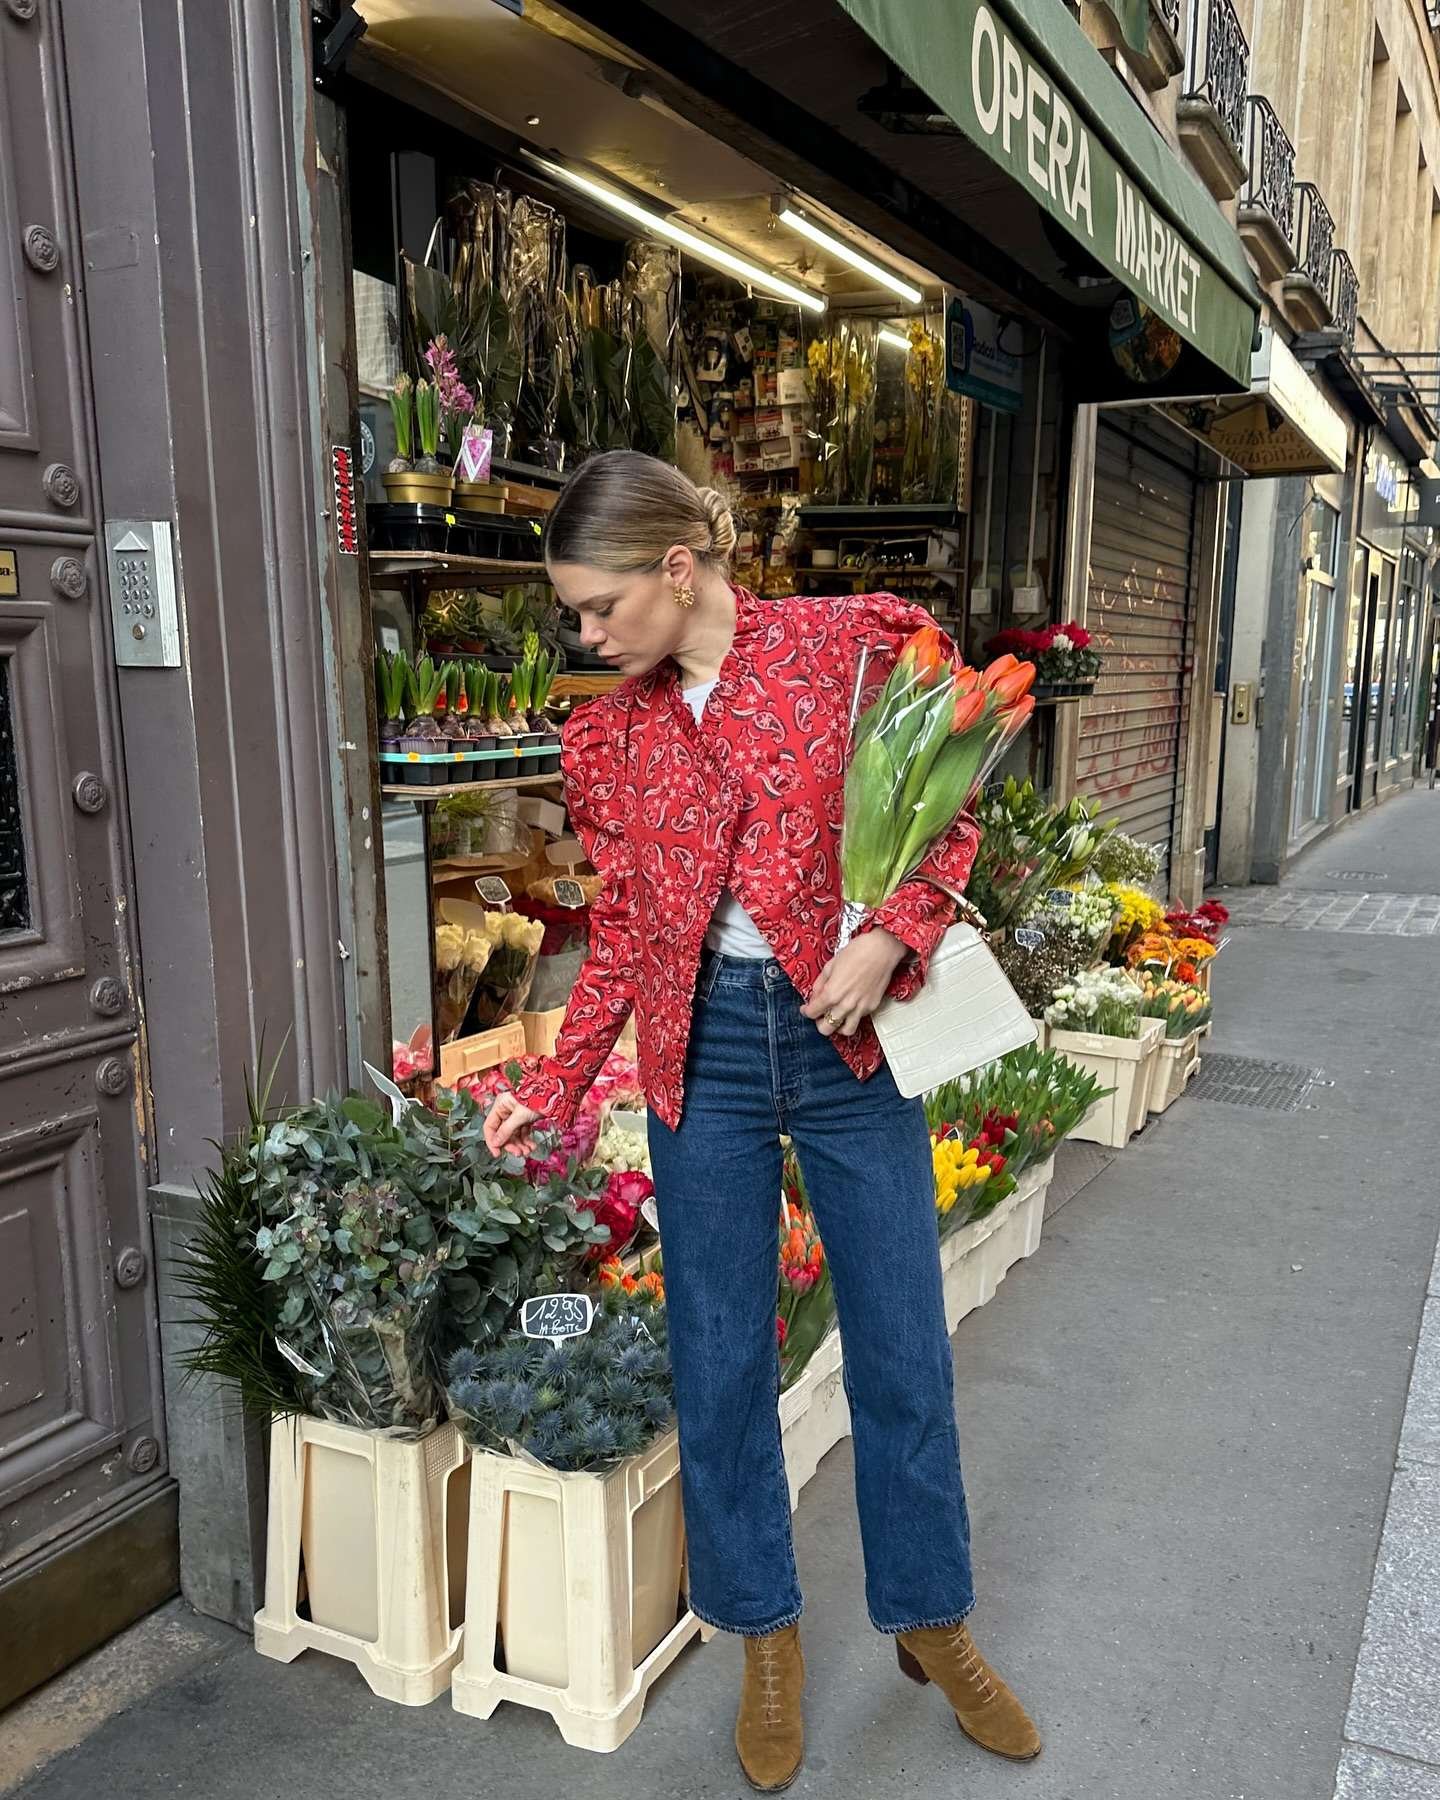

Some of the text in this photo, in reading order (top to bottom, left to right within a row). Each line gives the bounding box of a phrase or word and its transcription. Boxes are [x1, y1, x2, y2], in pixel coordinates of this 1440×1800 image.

[971, 6, 1094, 238] OPERA
[1115, 171, 1201, 335] MARKET
[526, 1296, 584, 1322] 12.95
